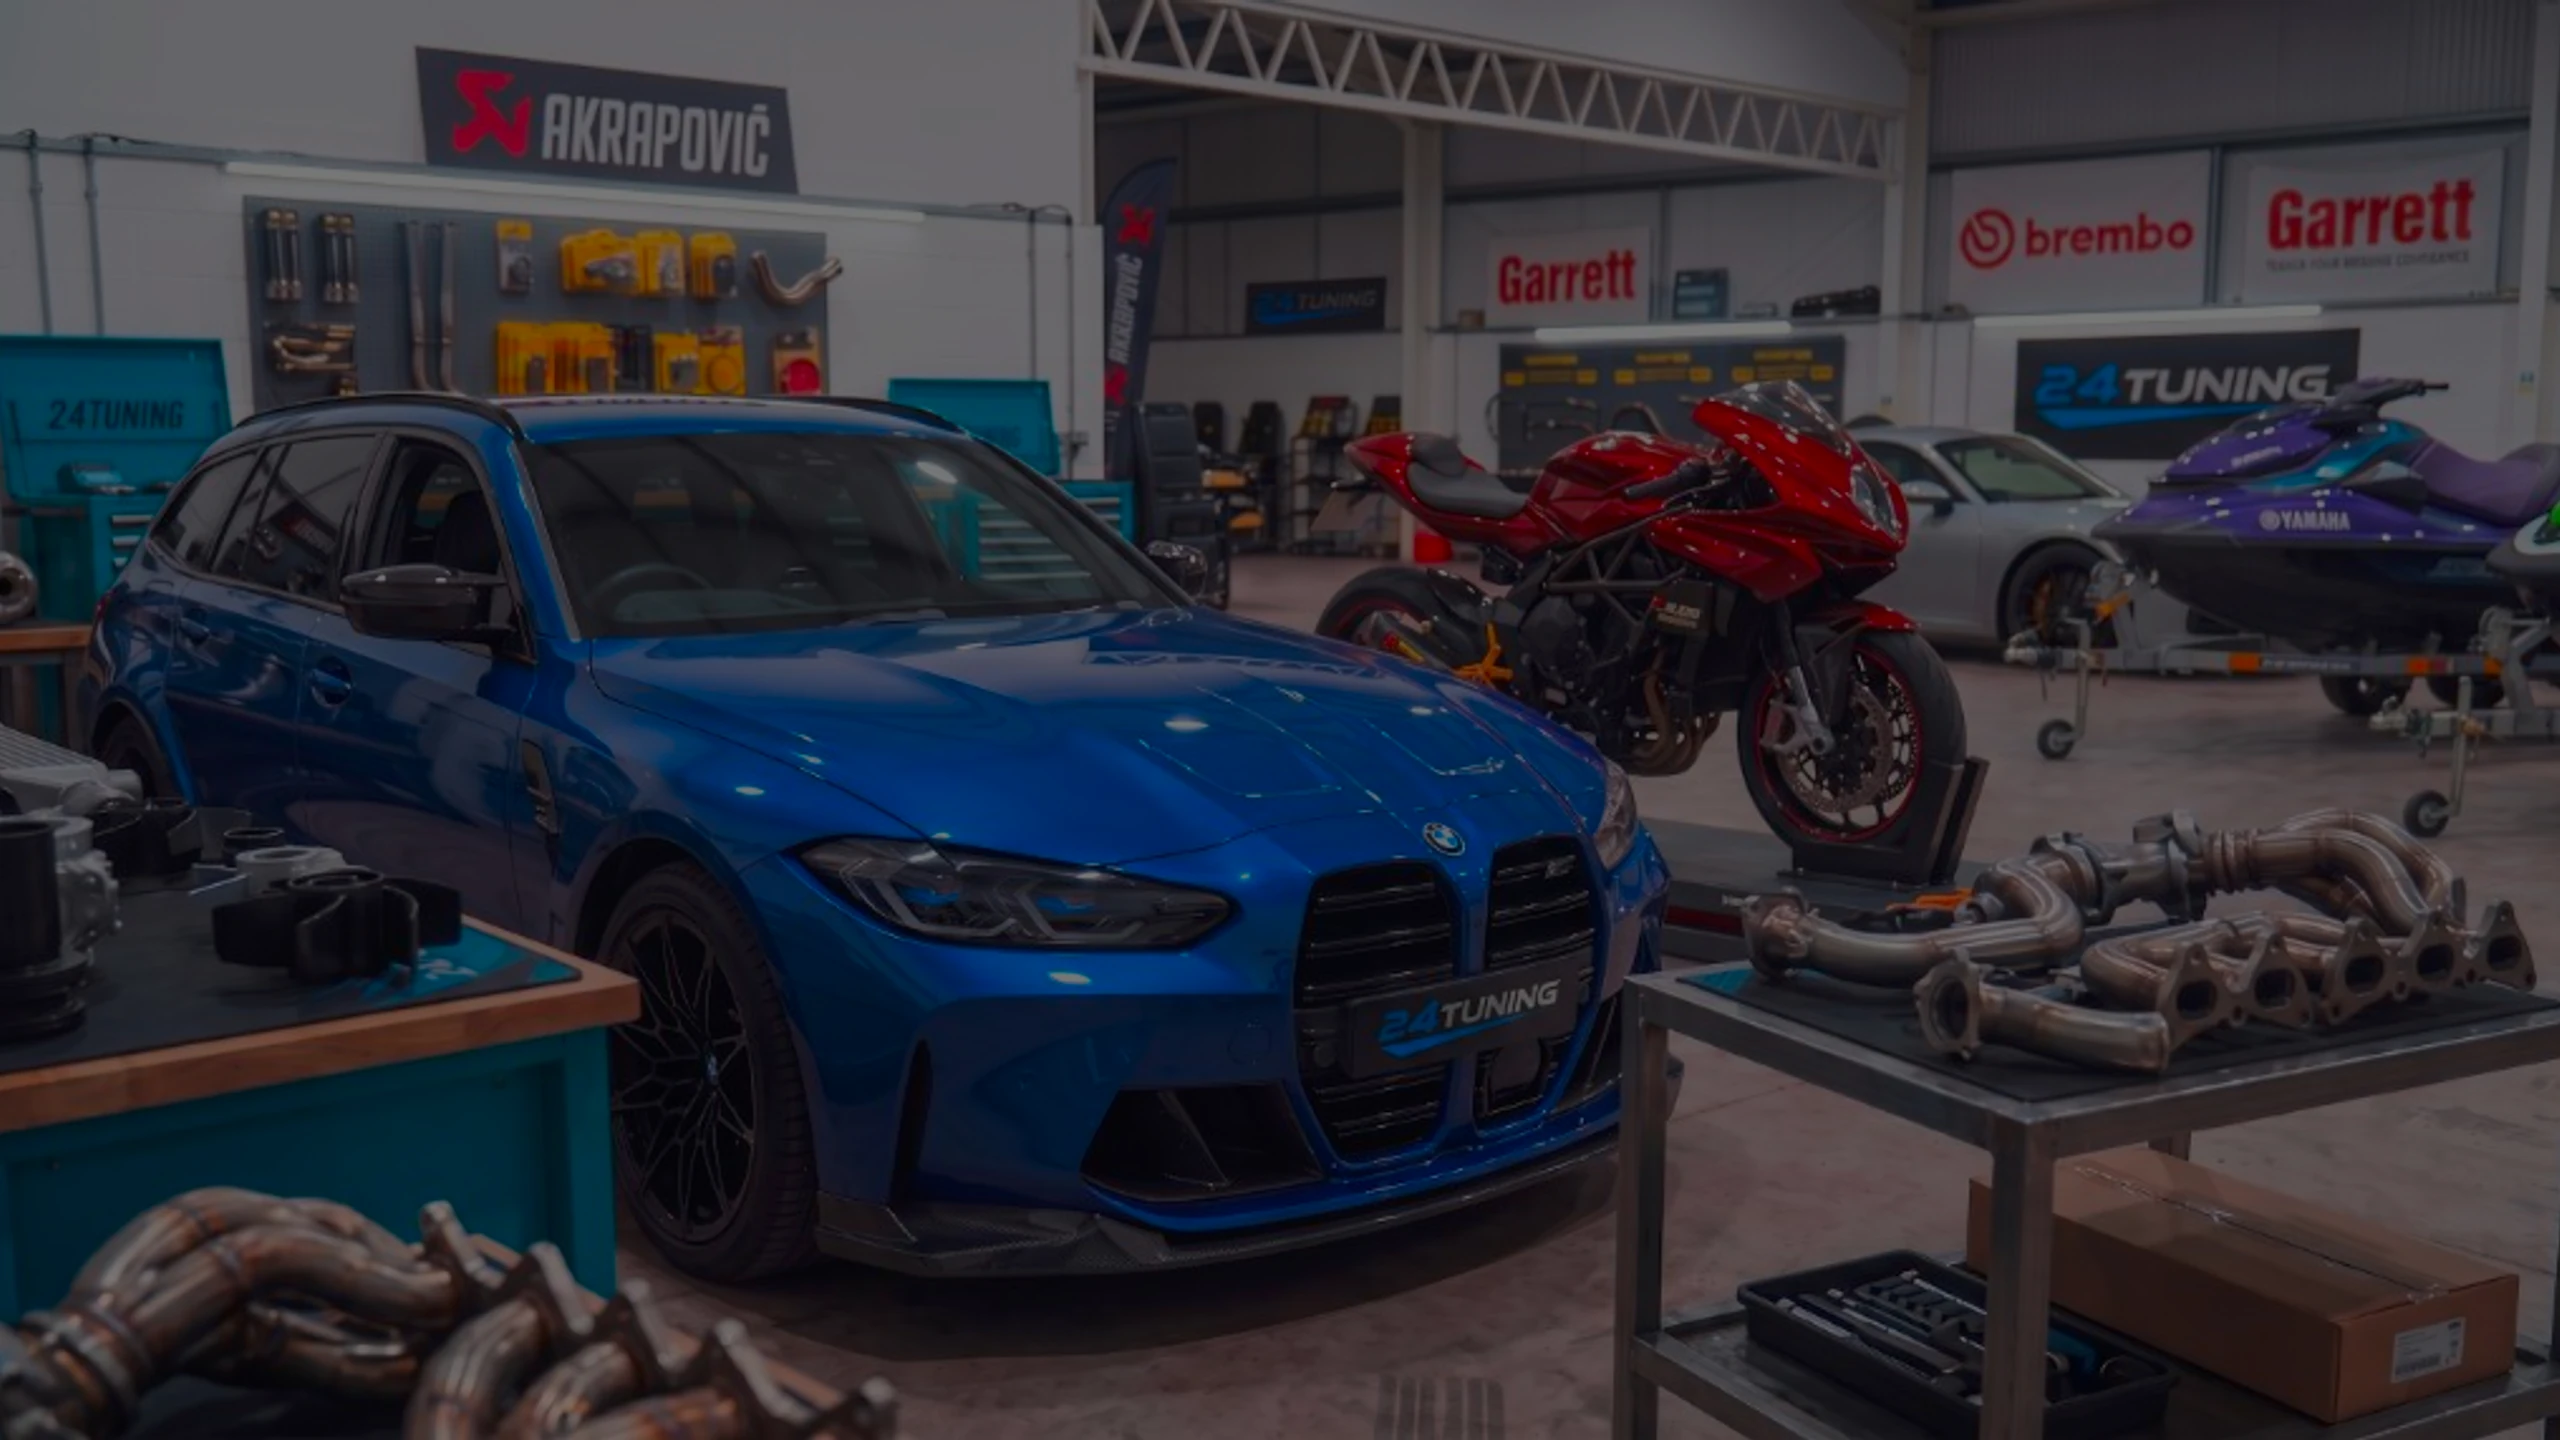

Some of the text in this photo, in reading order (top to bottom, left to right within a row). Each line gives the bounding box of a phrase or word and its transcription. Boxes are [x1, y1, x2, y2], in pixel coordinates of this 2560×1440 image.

[541, 92, 771, 177] AKRAPOVIČ
[2025, 211, 2194, 257] brembo
[2268, 178, 2475, 250] Garrett
[1498, 249, 1636, 305] Garrett
[49, 398, 184, 431] 24TUNING
[2281, 509, 2351, 532] YAMAHA
